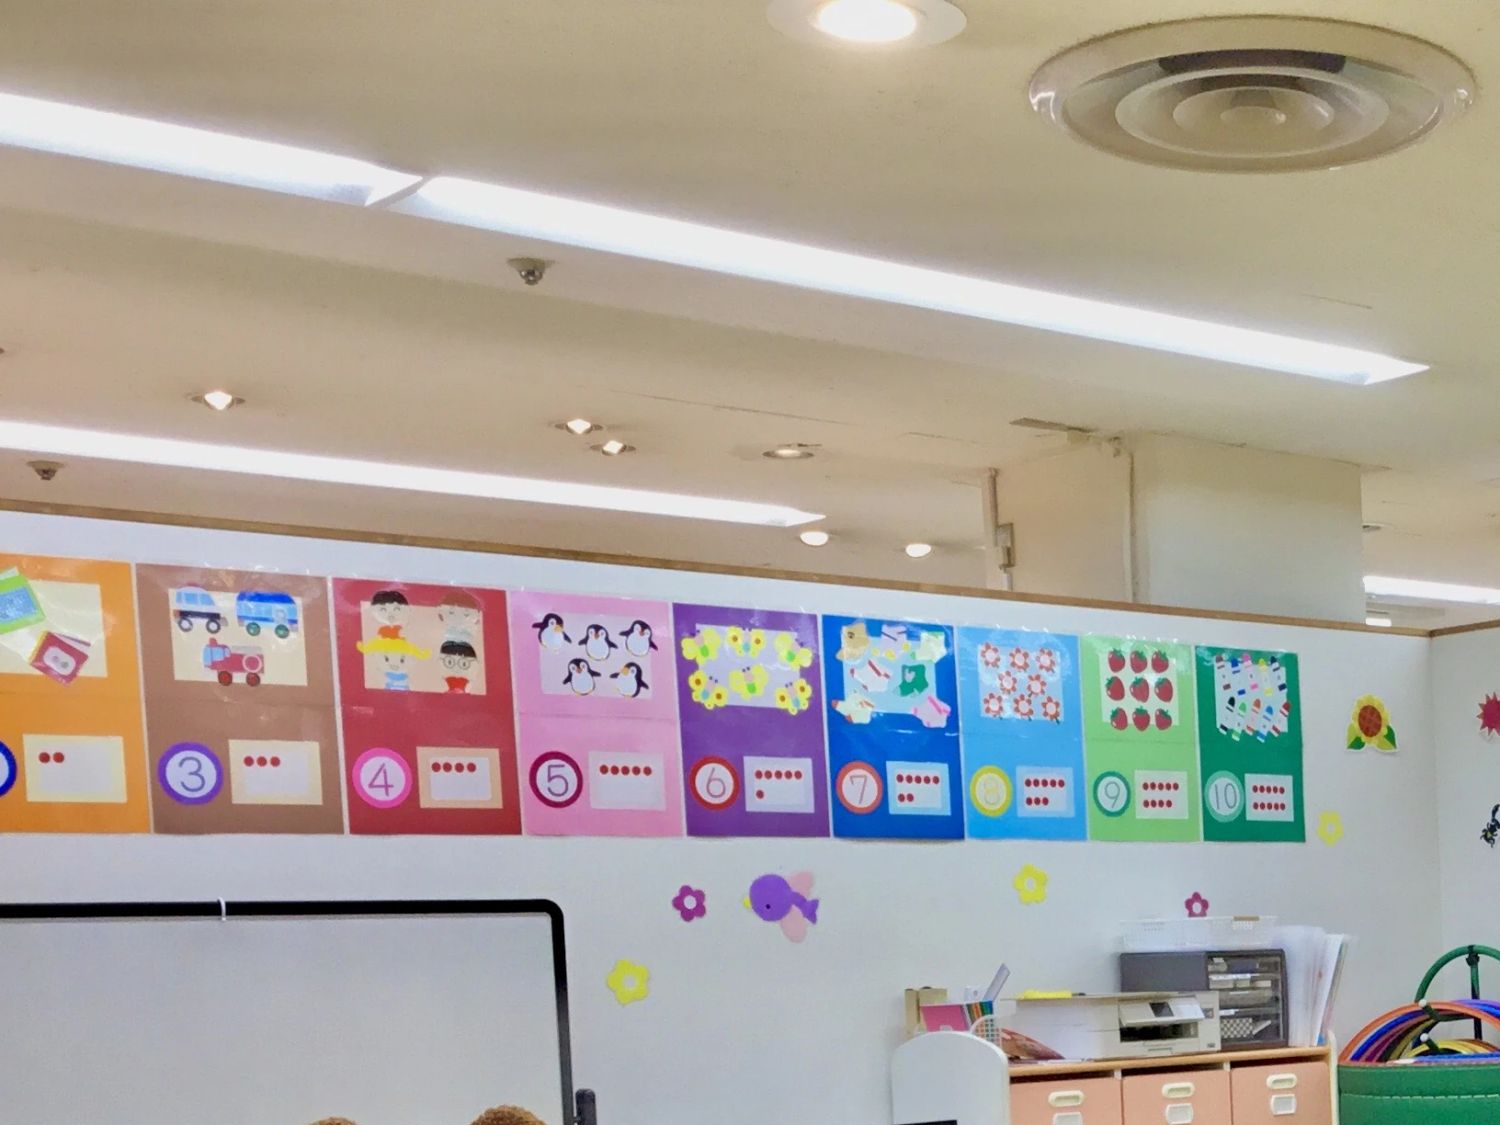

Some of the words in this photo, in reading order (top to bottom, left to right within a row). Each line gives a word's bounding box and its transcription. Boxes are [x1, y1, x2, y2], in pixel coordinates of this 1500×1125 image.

[178, 756, 206, 793] 3
[367, 763, 395, 797] 4
[547, 764, 569, 797] 5
[706, 767, 726, 798] 6
[849, 774, 868, 804] 7
[983, 777, 1000, 805] 8
[1104, 781, 1121, 808] 9
[1214, 782, 1238, 810] 10
